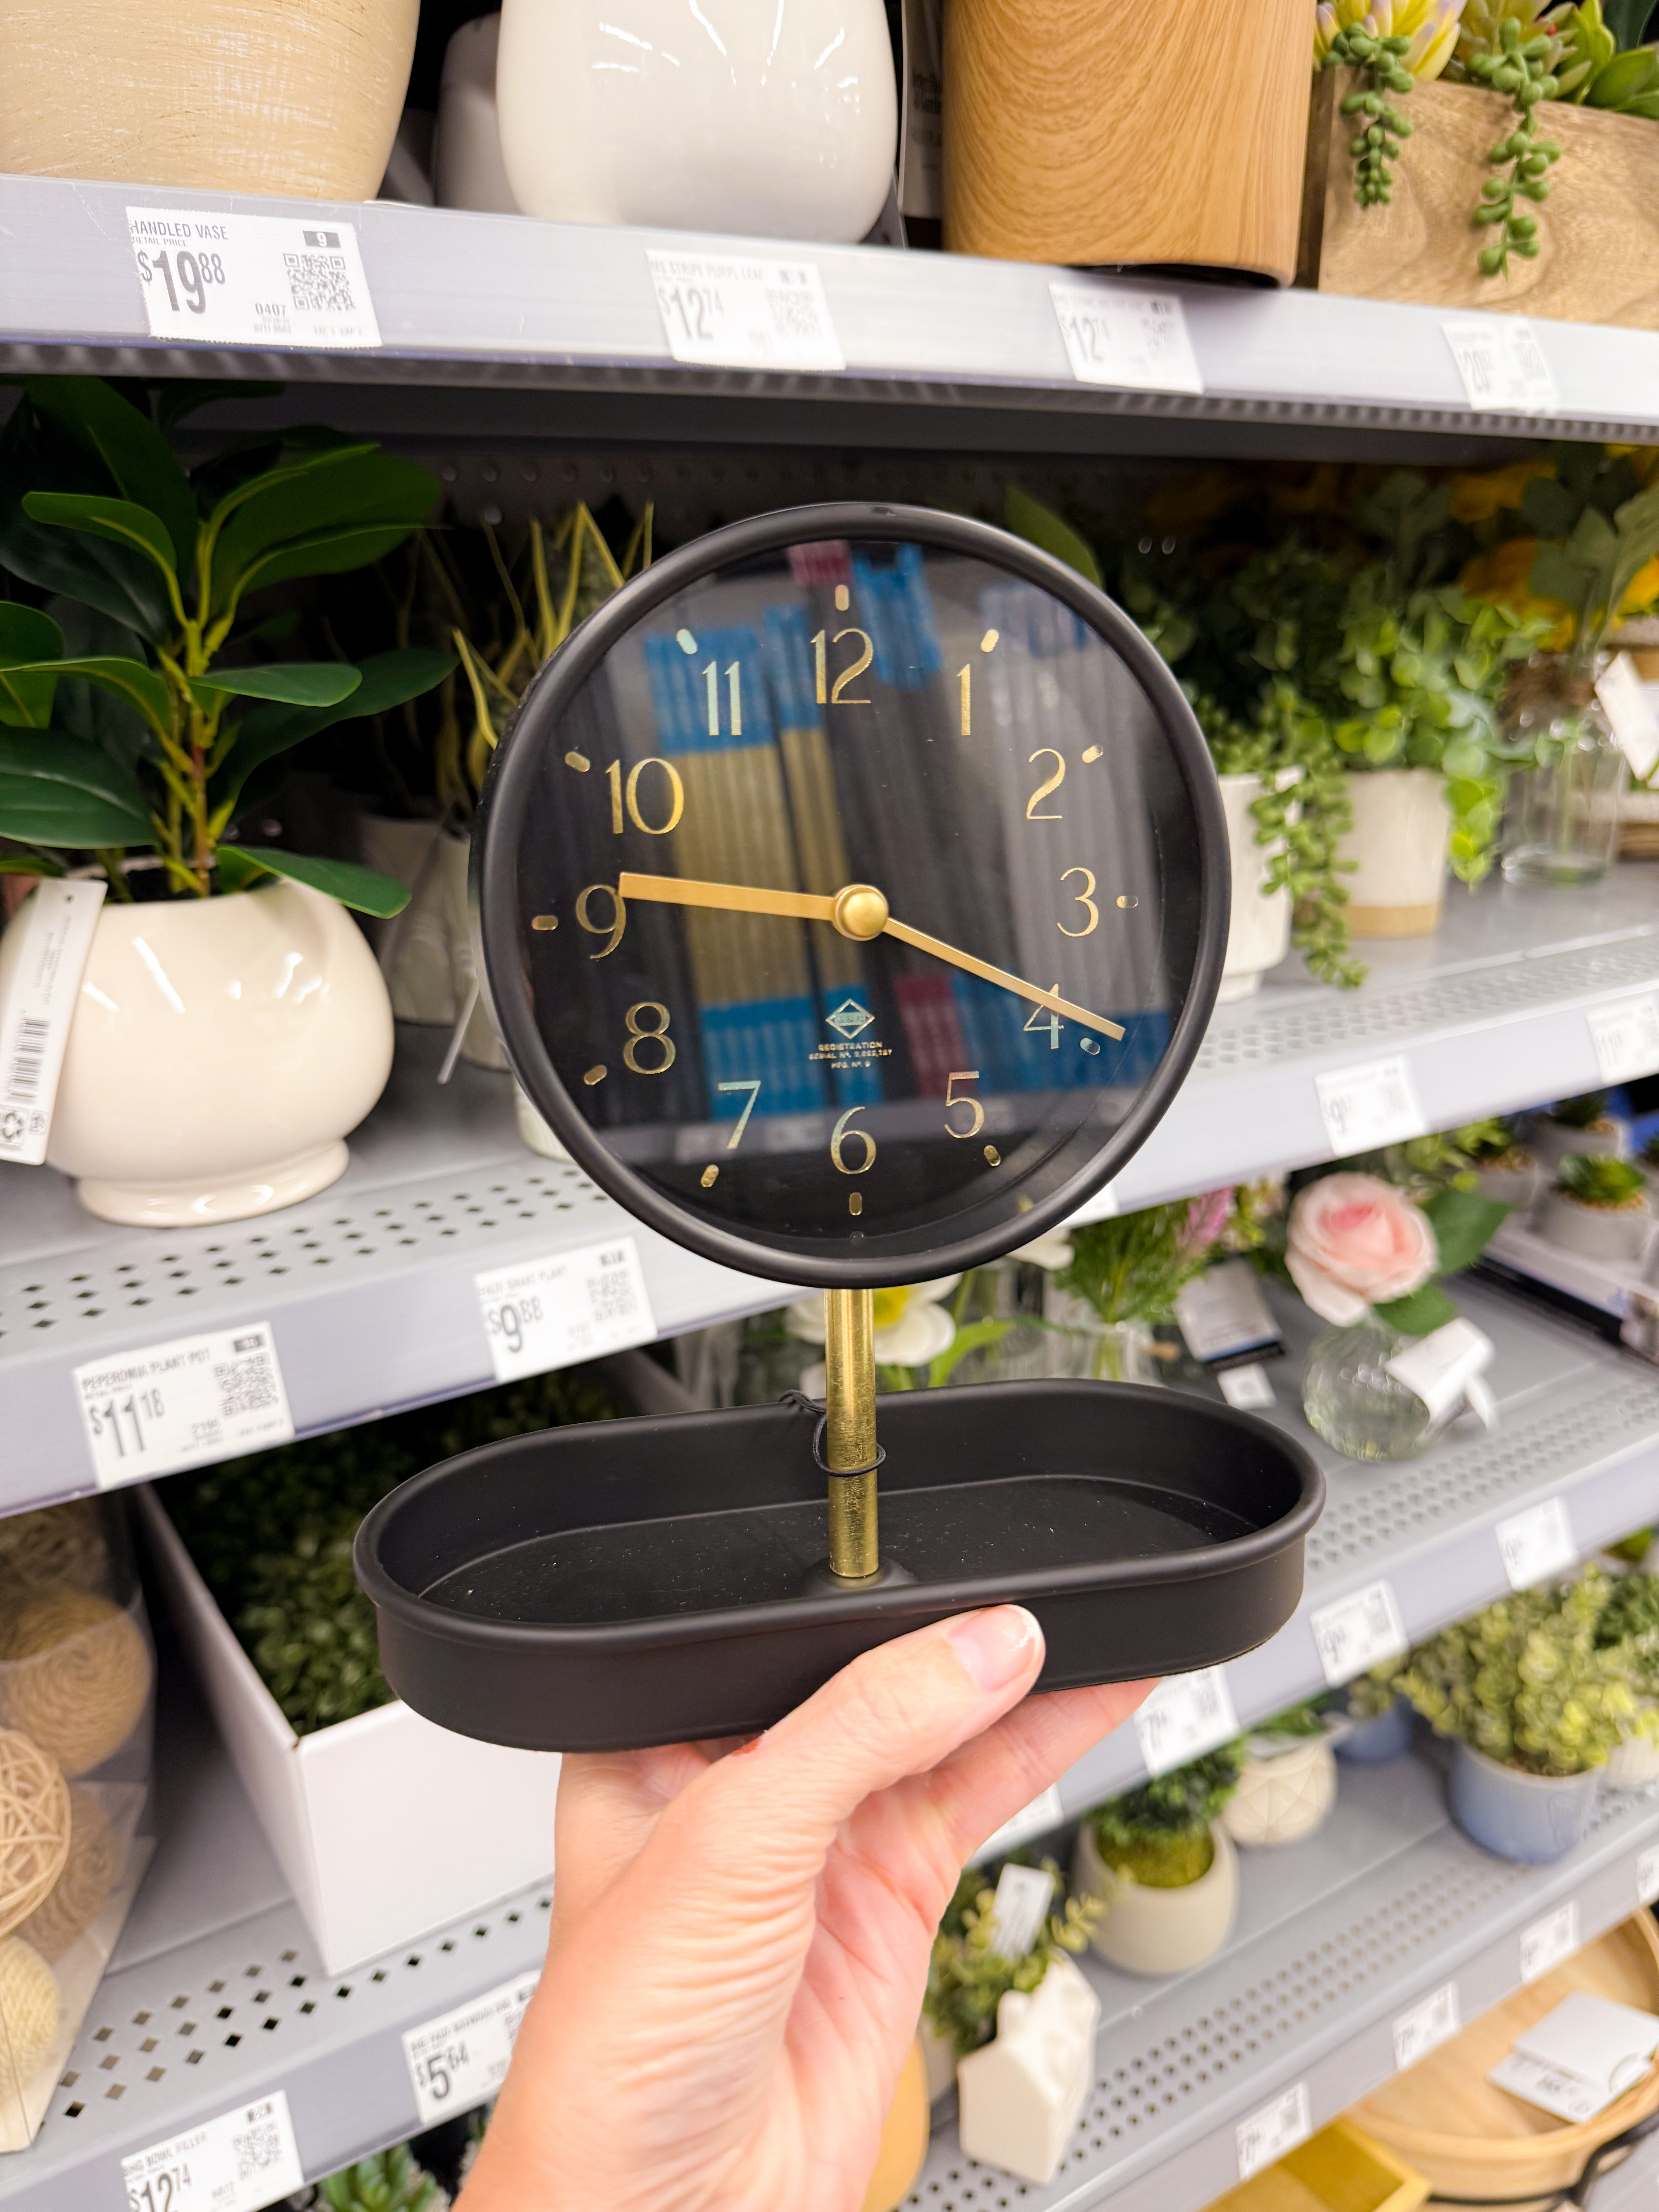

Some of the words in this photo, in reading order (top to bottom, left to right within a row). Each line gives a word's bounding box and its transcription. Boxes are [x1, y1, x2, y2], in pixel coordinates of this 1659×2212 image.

[130, 220, 191, 237] HANDLED
[195, 224, 228, 240] VASE
[163, 238, 188, 247] PRICE
[317, 232, 328, 247] 9
[701, 660, 743, 737] 11
[810, 627, 873, 706] 12
[956, 663, 971, 737] 1
[604, 757, 685, 835] 10
[1024, 747, 1066, 820] 2
[575, 883, 627, 960] 9
[1056, 866, 1099, 938] 3
[622, 1001, 676, 1075] 8
[818, 1041, 883, 1051] REGISTRATION
[1022, 983, 1065, 1049] 4
[718, 1080, 761, 1150] 7
[830, 1104, 877, 1175] 6
[944, 1071, 984, 1139] 5
